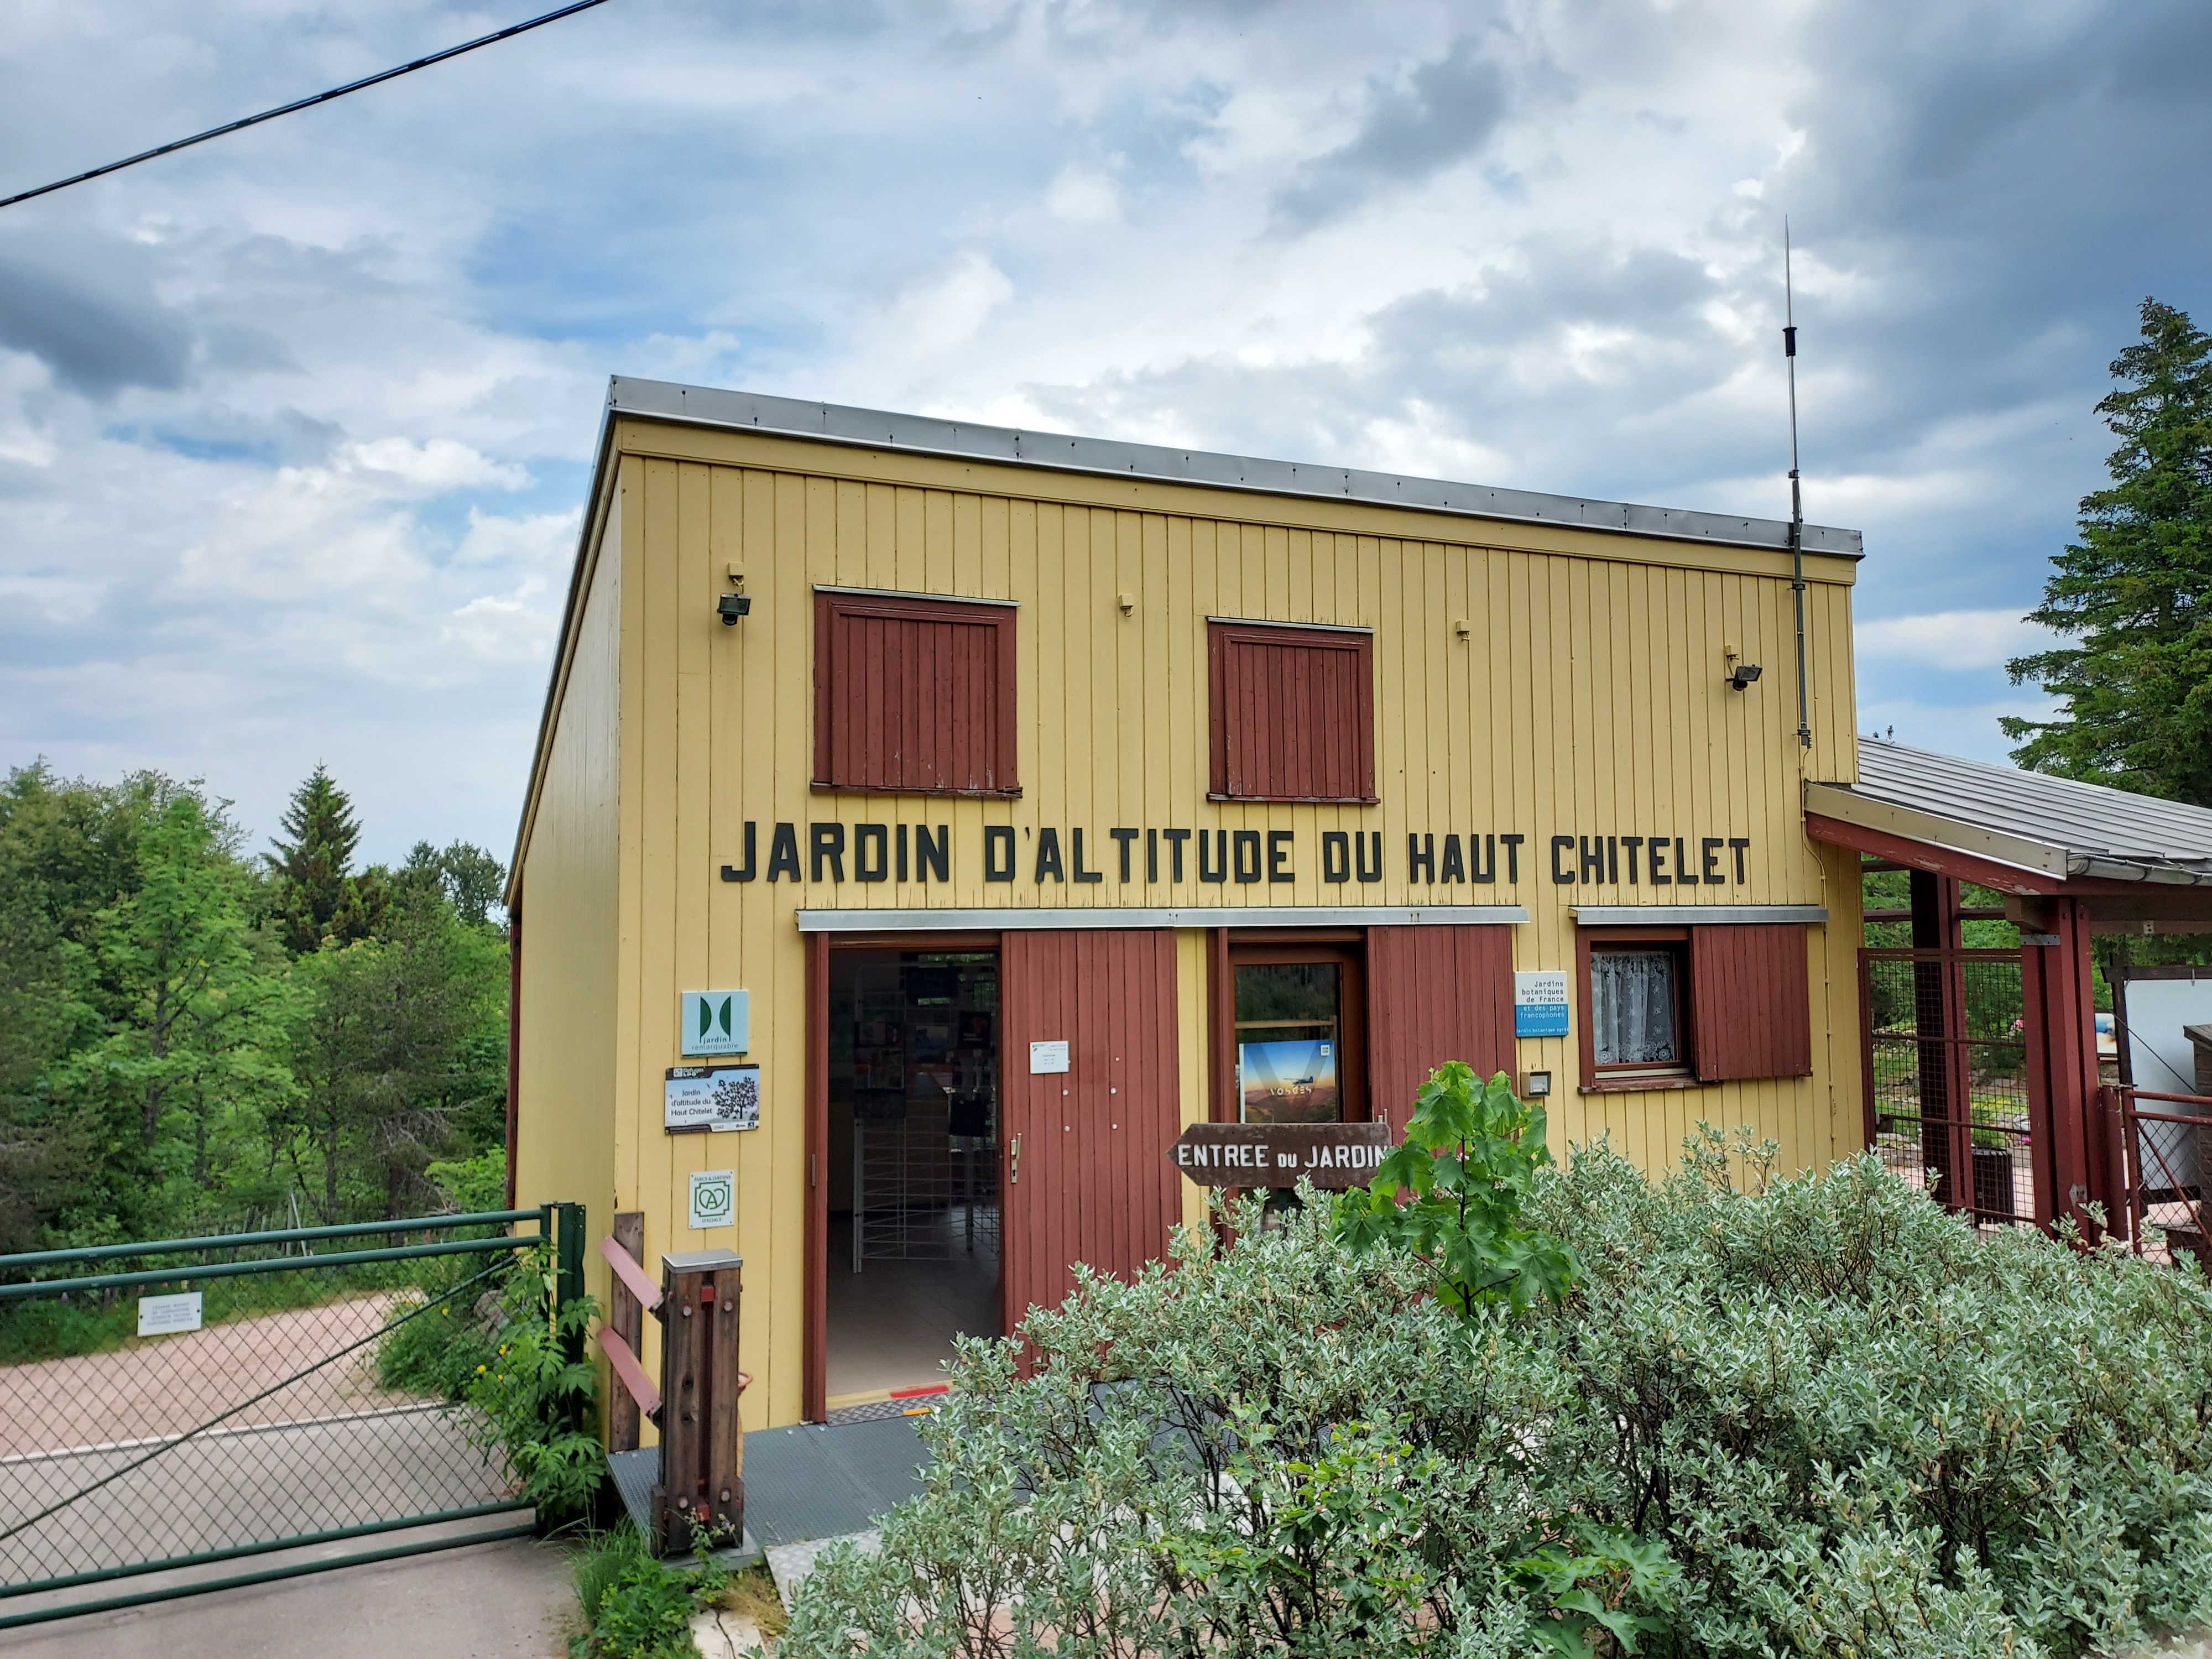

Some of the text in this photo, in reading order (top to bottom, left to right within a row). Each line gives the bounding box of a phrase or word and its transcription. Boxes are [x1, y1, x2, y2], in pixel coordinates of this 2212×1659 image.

[721, 821, 1750, 885] JARDIN D'ALTITUDE DU HAUT CHITELET
[1521, 988, 1564, 996] botaniques
[703, 1036, 727, 1045] jardin
[671, 1098, 701, 1107] d'altitude
[1177, 1144, 1270, 1168] ENTREE
[1304, 1144, 1388, 1168] JARDIN
